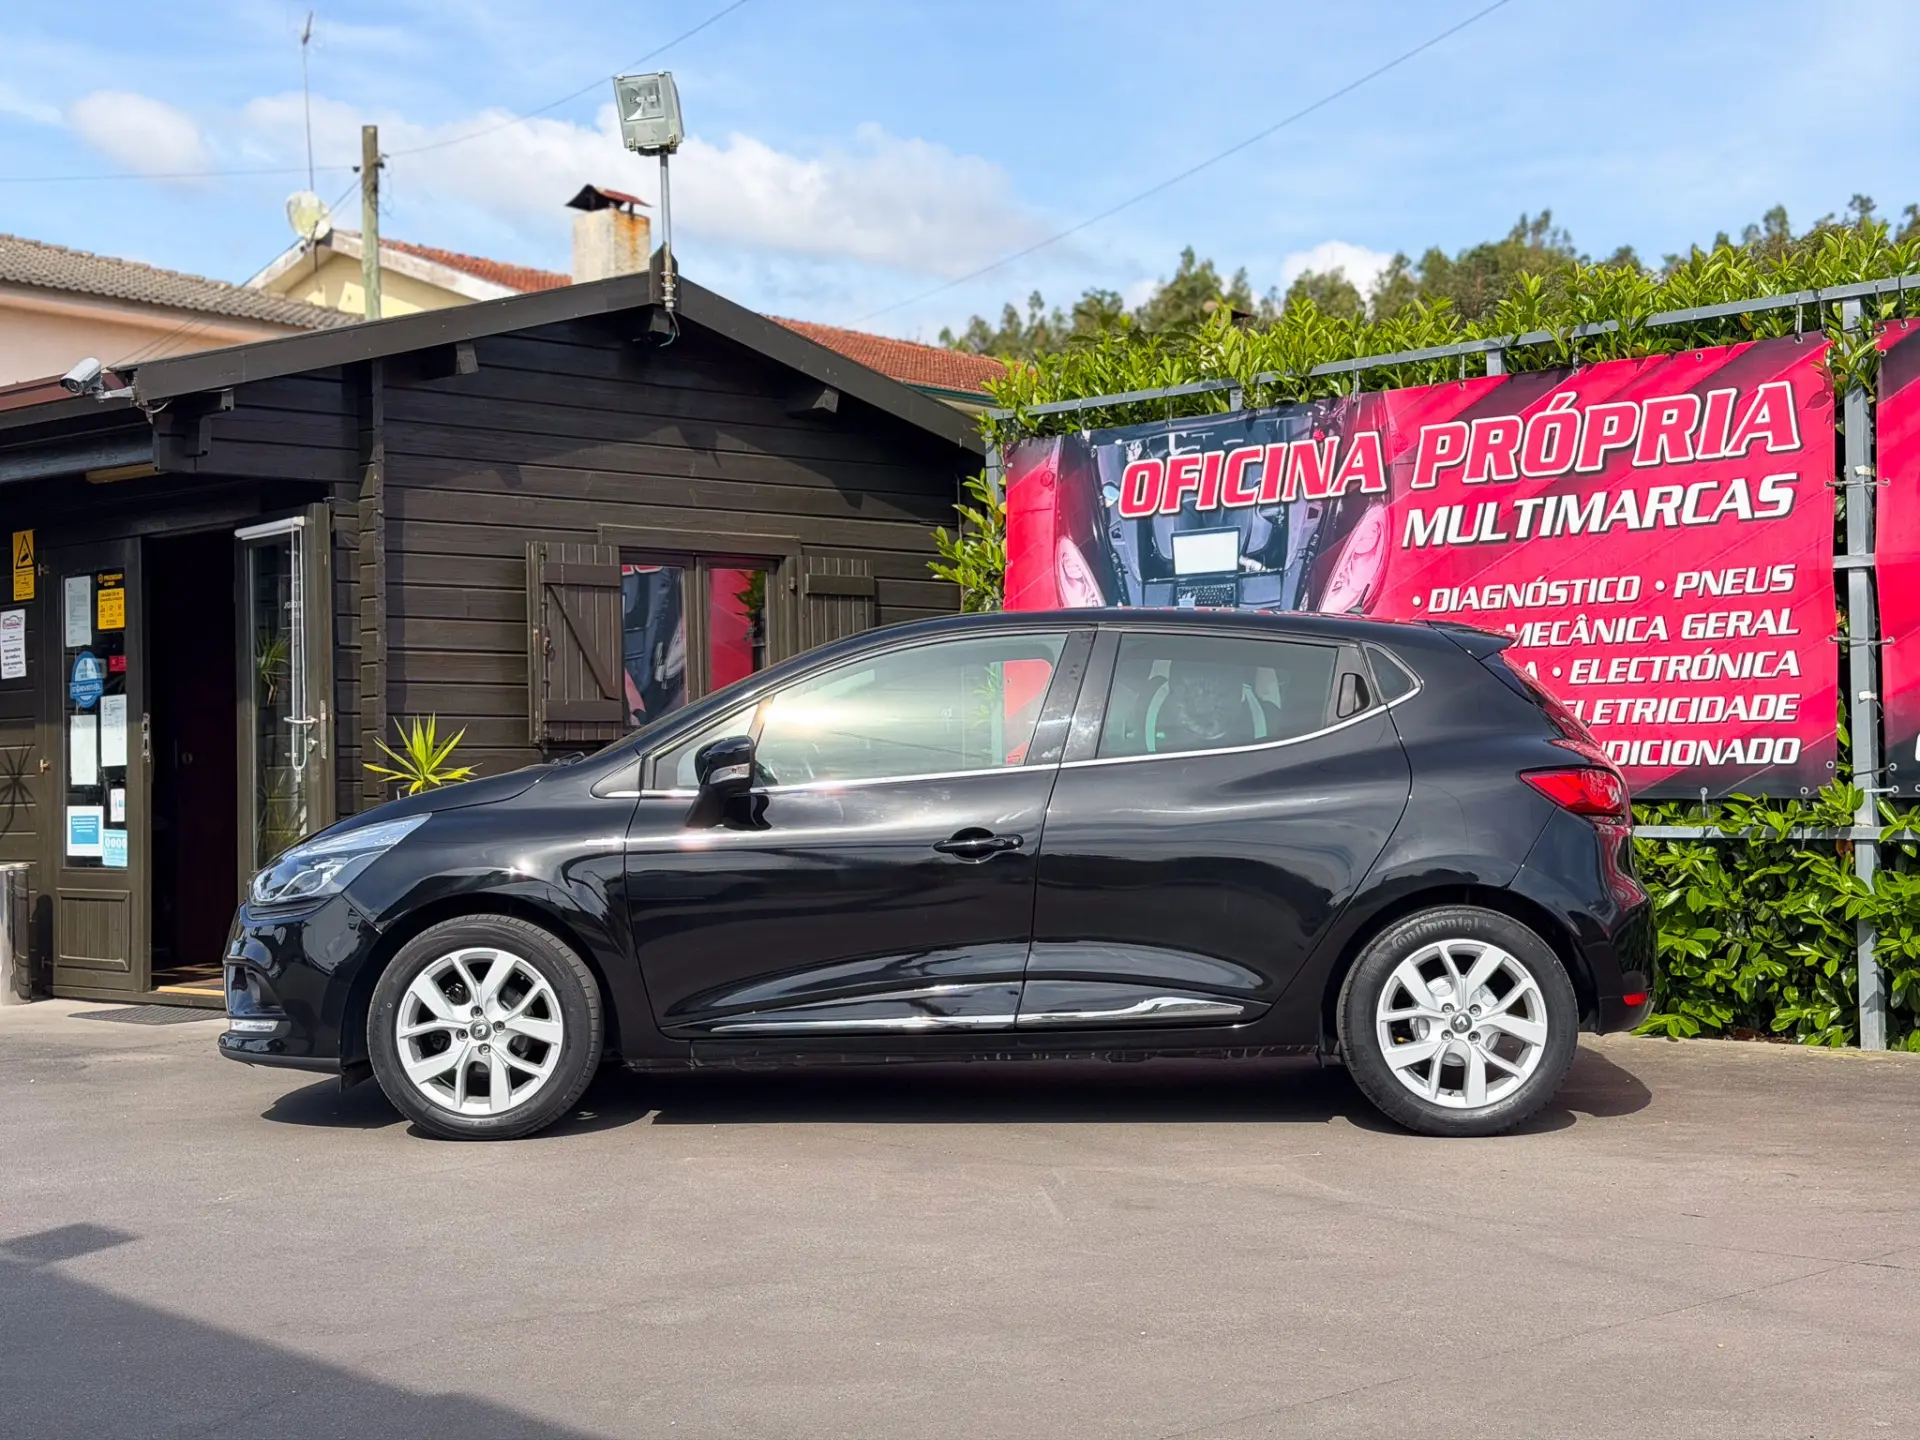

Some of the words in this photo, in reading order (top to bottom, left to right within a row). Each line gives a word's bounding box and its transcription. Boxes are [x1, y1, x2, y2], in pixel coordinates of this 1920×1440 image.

[1118, 430, 1387, 518] OFICINA
[1410, 380, 1801, 489] PRÓPRIA
[1402, 472, 1797, 548] MULTIMARCAS
[1428, 576, 1642, 614] DIAGNÓSTICO
[1673, 564, 1796, 598] PNEUS
[1681, 608, 1799, 640] GERAL
[1568, 648, 1800, 685] ELECTRÓNICA
[1562, 694, 1801, 725] LETRICIDADE
